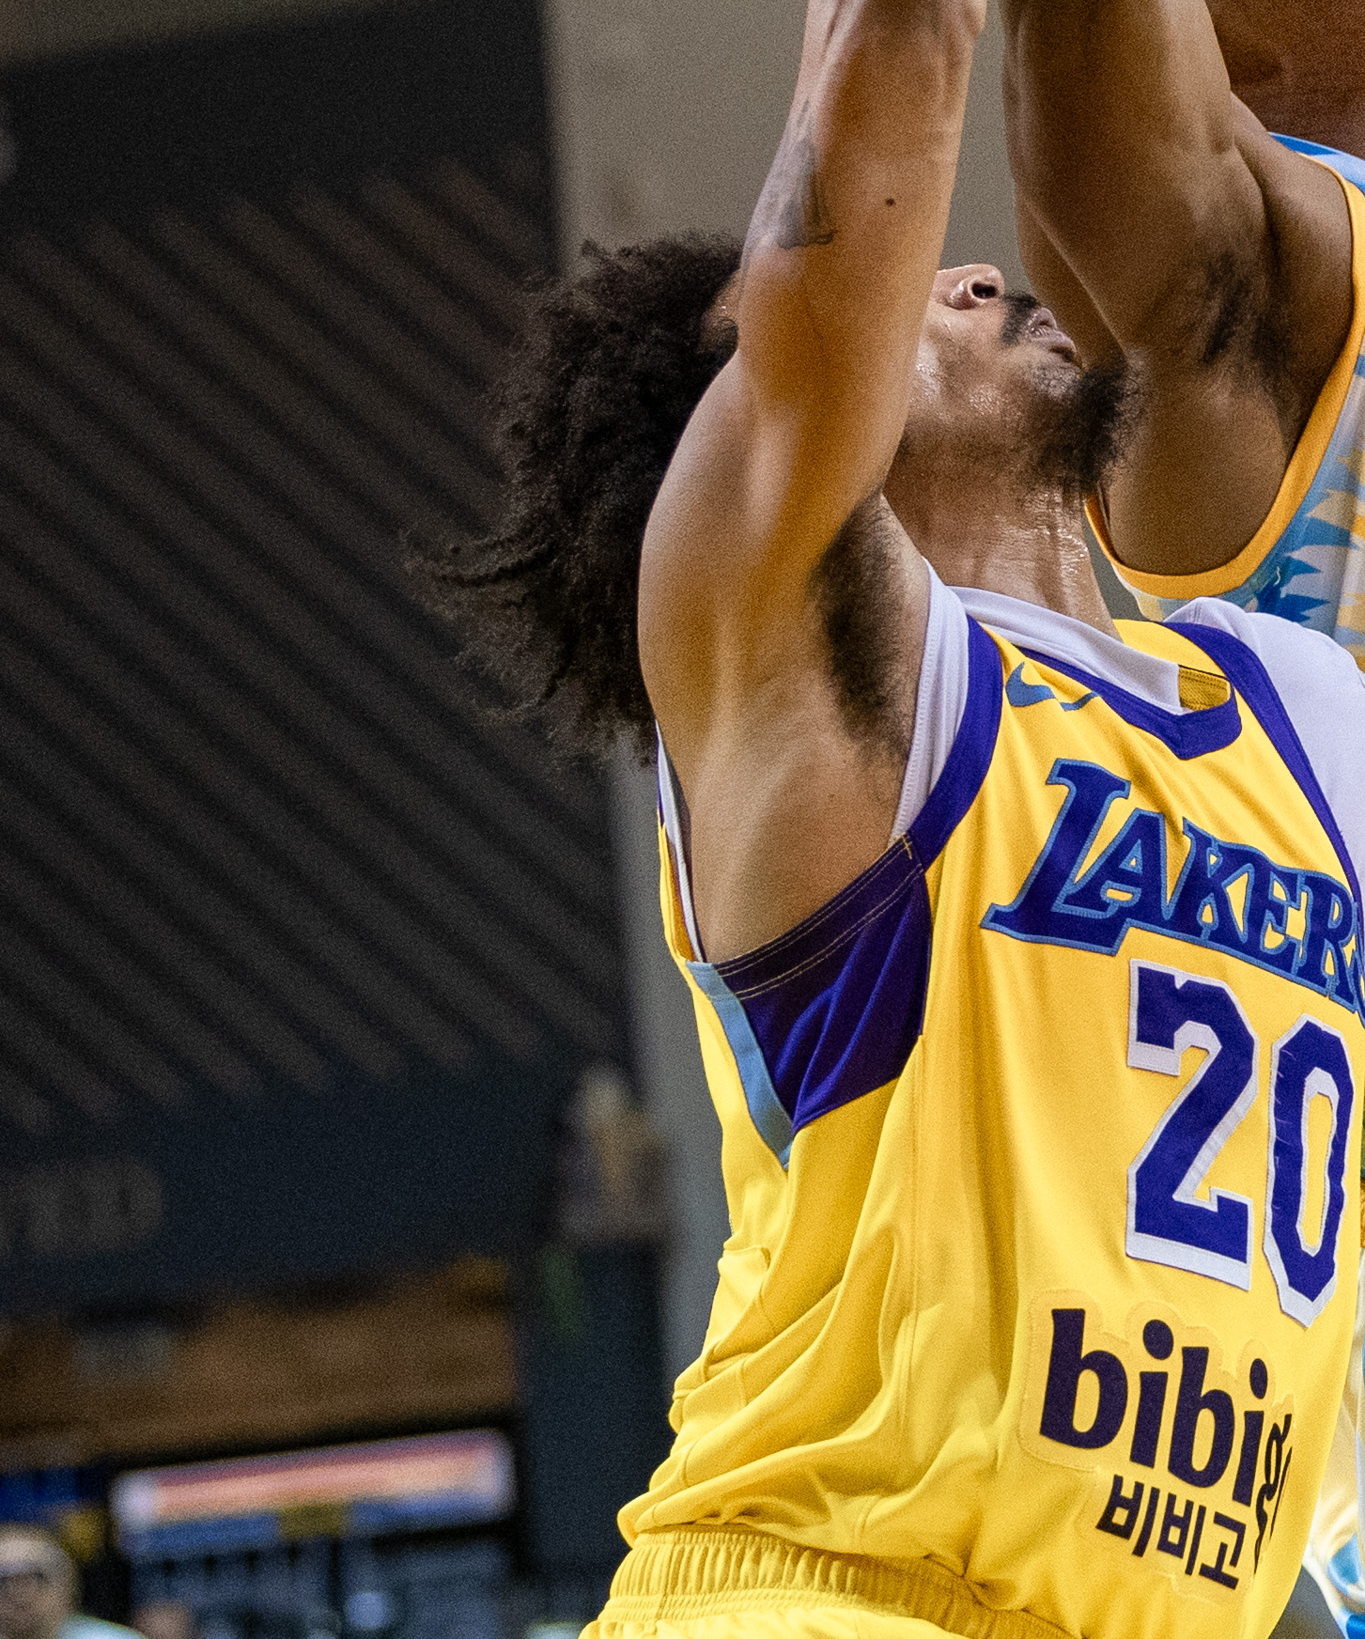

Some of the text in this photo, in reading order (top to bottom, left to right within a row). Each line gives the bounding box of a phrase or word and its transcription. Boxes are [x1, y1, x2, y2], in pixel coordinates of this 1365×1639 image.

[1127, 959, 1357, 1329] 20
[1040, 1308, 1293, 1575] bibig
[1095, 1473, 1247, 1591] 비비고
